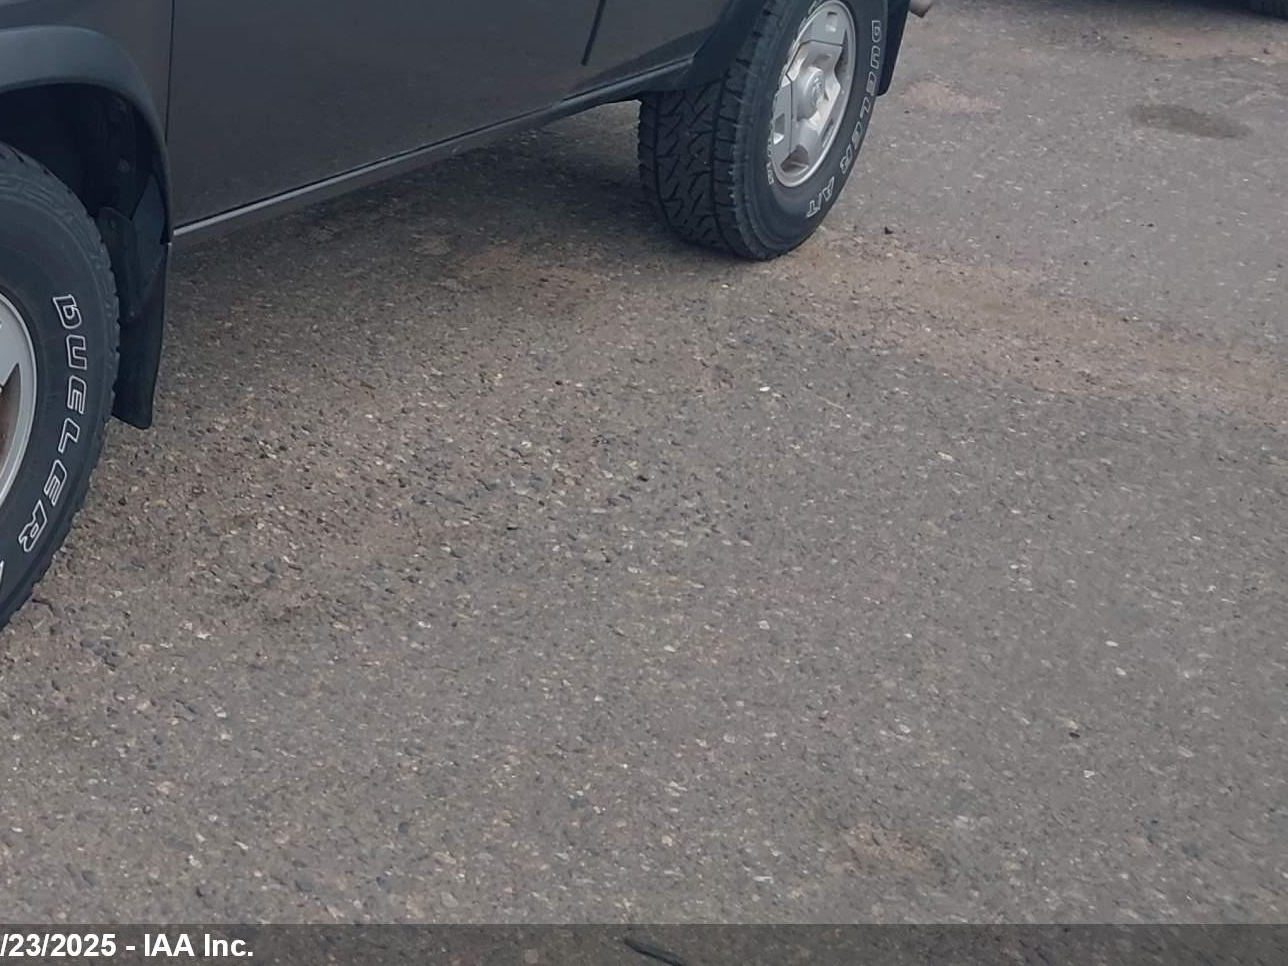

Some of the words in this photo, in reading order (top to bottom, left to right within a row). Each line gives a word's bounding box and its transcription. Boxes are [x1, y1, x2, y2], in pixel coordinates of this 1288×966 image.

[840, 20, 881, 174] DUELER
[806, 176, 835, 218] A/T
[19, 294, 87, 552] DUELER
